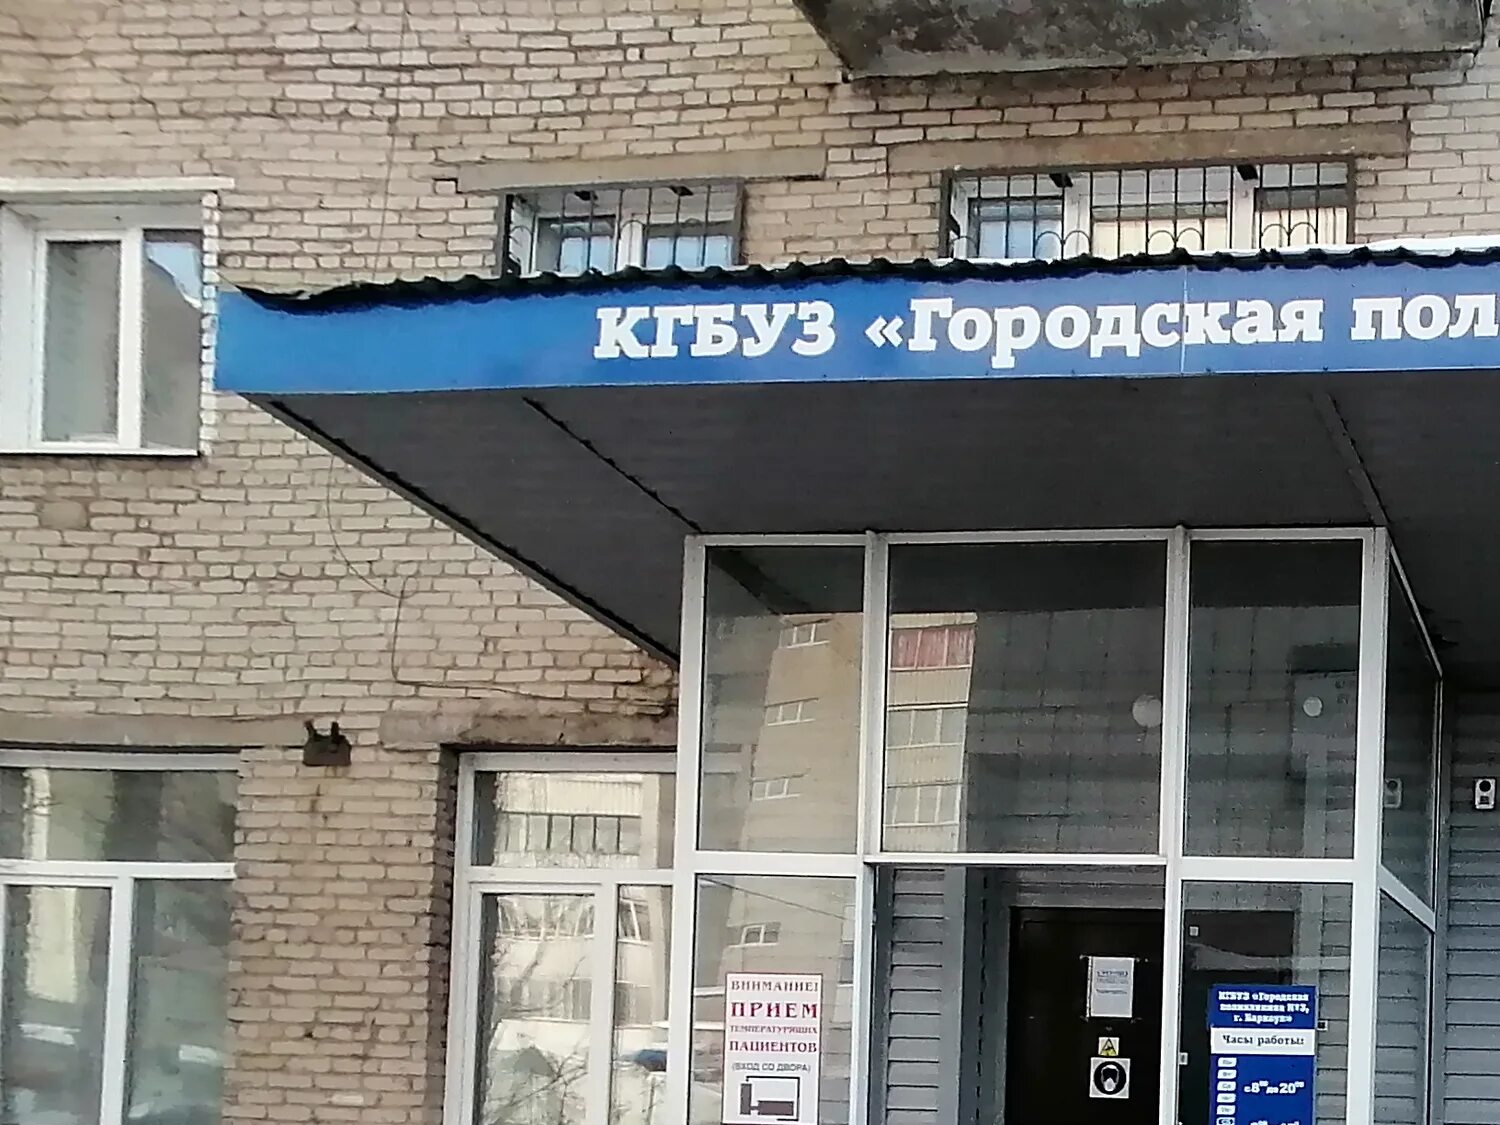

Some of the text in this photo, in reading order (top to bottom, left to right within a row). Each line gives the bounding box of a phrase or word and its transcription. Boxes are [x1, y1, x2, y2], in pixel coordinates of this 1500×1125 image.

[594, 301, 836, 359] КГБУЗ
[865, 297, 1324, 369] «Городская
[731, 1002, 818, 1018] ПРИЕМ
[729, 1040, 818, 1053] ПАЦИЕНТОВ
[1222, 1034, 1305, 1047] Часы работы:
[761, 1063, 775, 1071] СО
